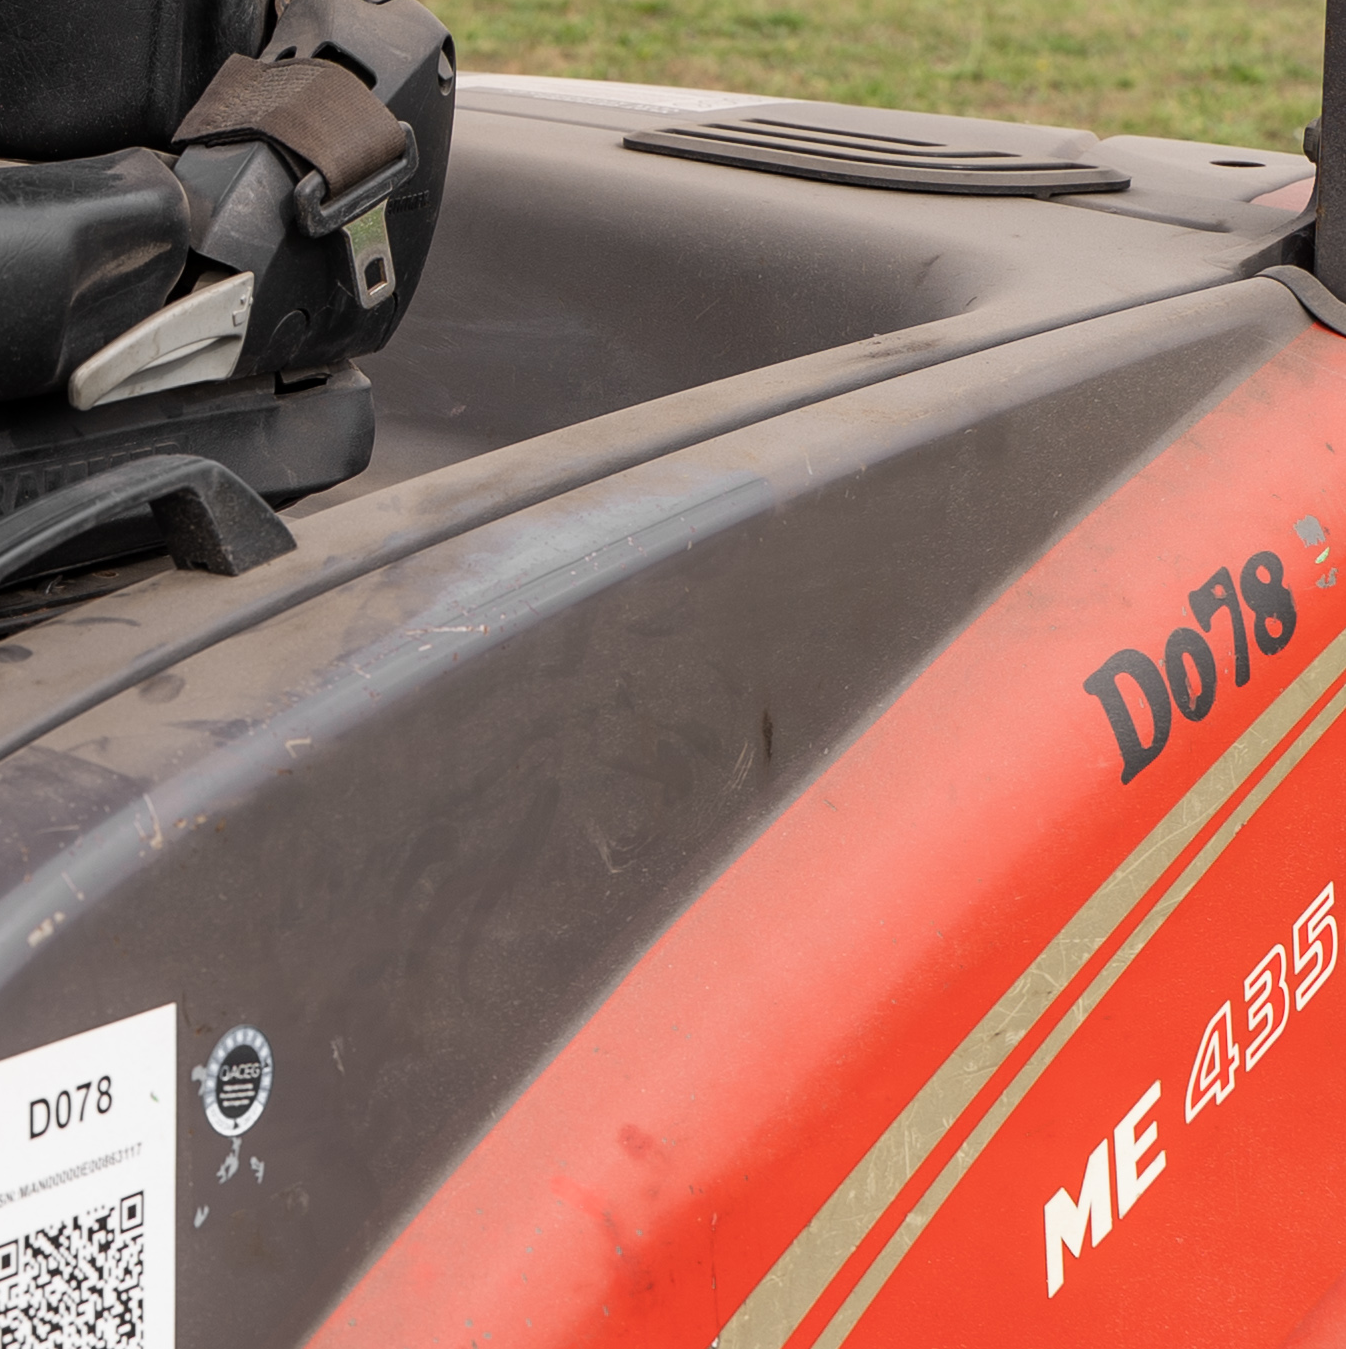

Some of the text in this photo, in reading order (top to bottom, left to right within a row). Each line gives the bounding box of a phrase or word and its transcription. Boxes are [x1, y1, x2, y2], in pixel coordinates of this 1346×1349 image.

[28, 1075, 114, 1141] D078
[1044, 881, 1338, 1298] ME 435
